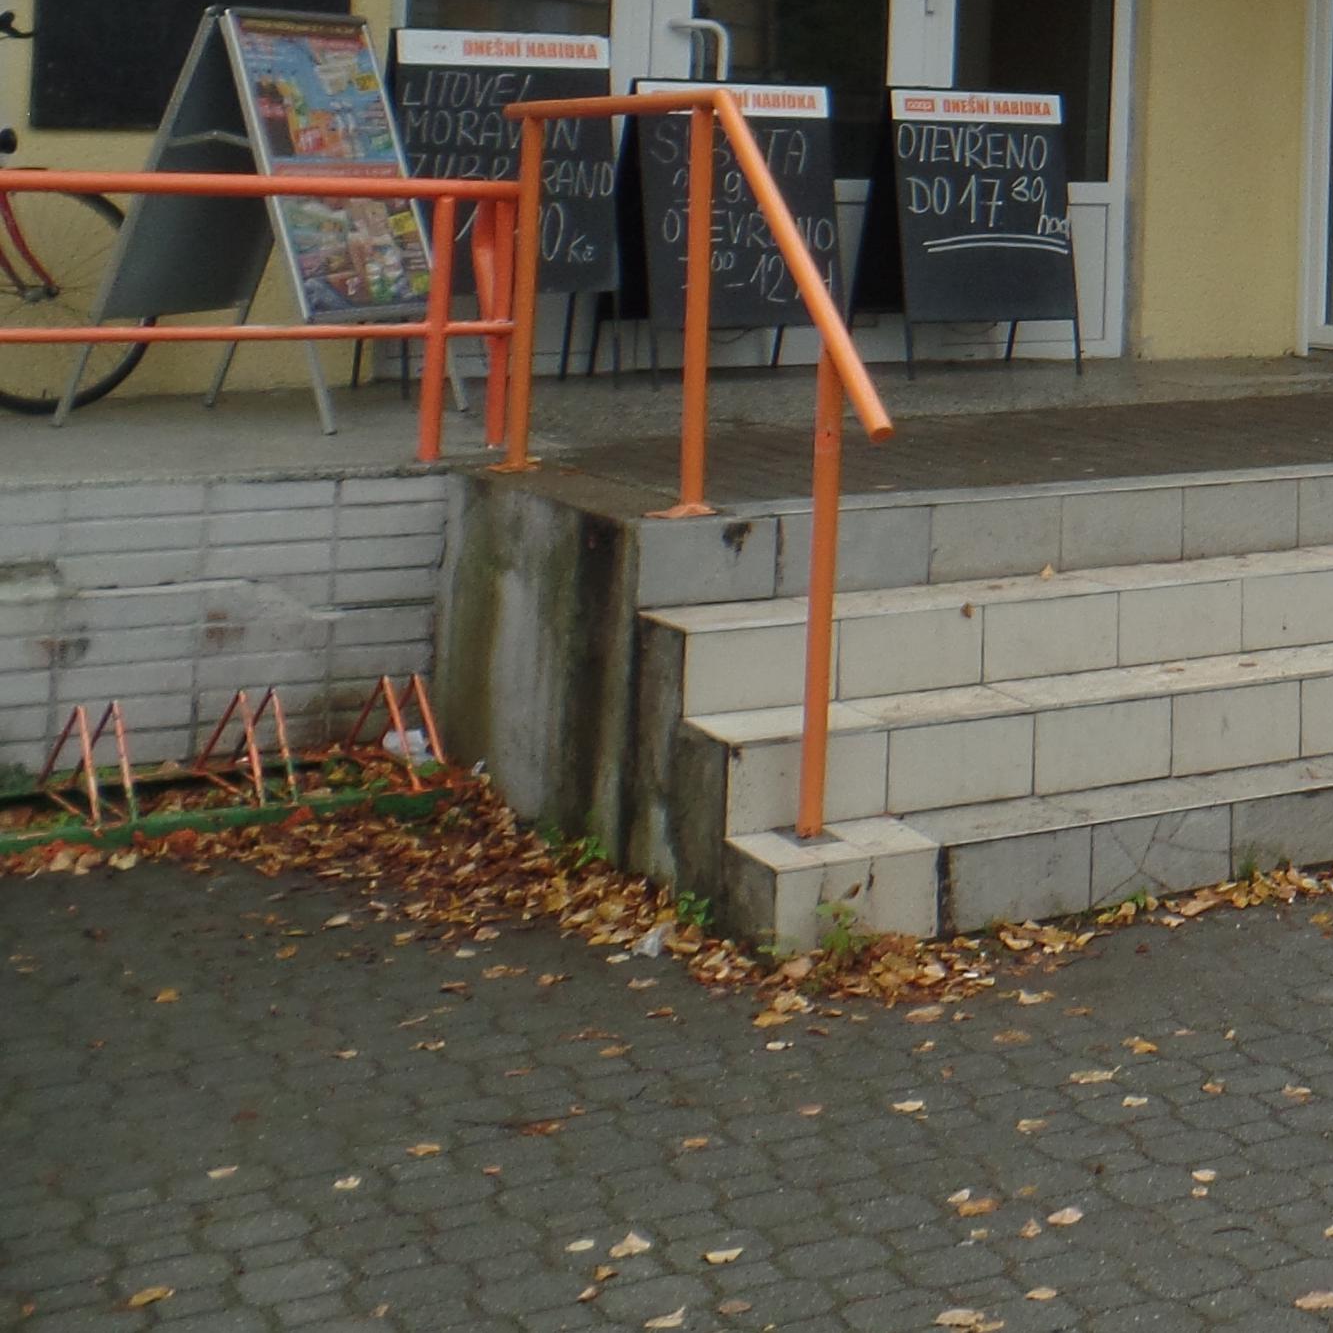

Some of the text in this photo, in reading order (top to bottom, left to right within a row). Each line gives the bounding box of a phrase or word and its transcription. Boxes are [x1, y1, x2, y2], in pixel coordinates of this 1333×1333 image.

[943, 94, 989, 113] DNEŠNÍ
[994, 98, 1051, 116] NABÍDKA
[897, 123, 1048, 171] OTEVŘENO
[906, 176, 950, 215] DO
